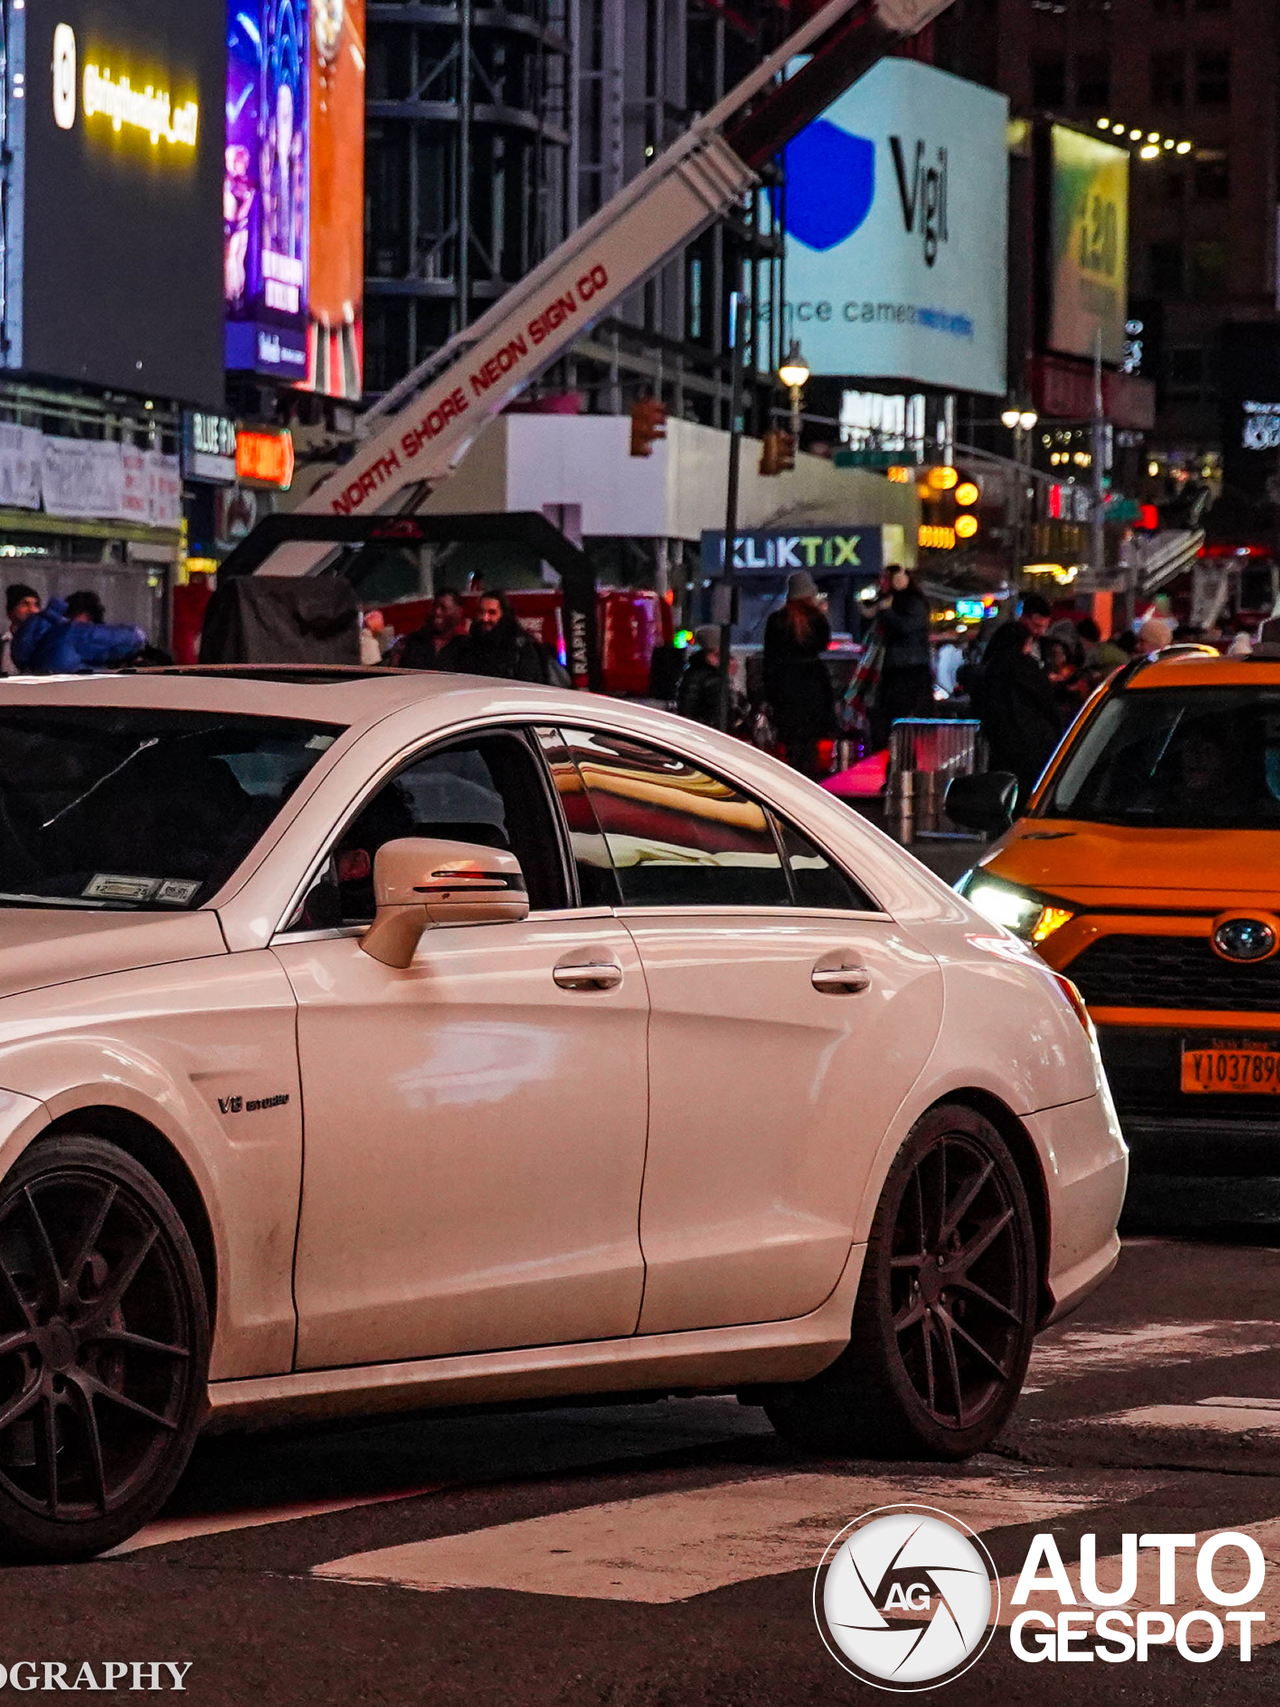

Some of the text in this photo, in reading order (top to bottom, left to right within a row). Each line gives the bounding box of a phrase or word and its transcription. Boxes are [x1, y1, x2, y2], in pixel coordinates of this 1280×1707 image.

[890, 135, 949, 267] Vigil
[330, 448, 402, 517] NORTH
[400, 389, 469, 459] SHORE
[469, 334, 529, 397] NEON
[528, 290, 578, 345] SIGN
[576, 264, 609, 302] CO
[719, 535, 862, 568] KLIKTIX
